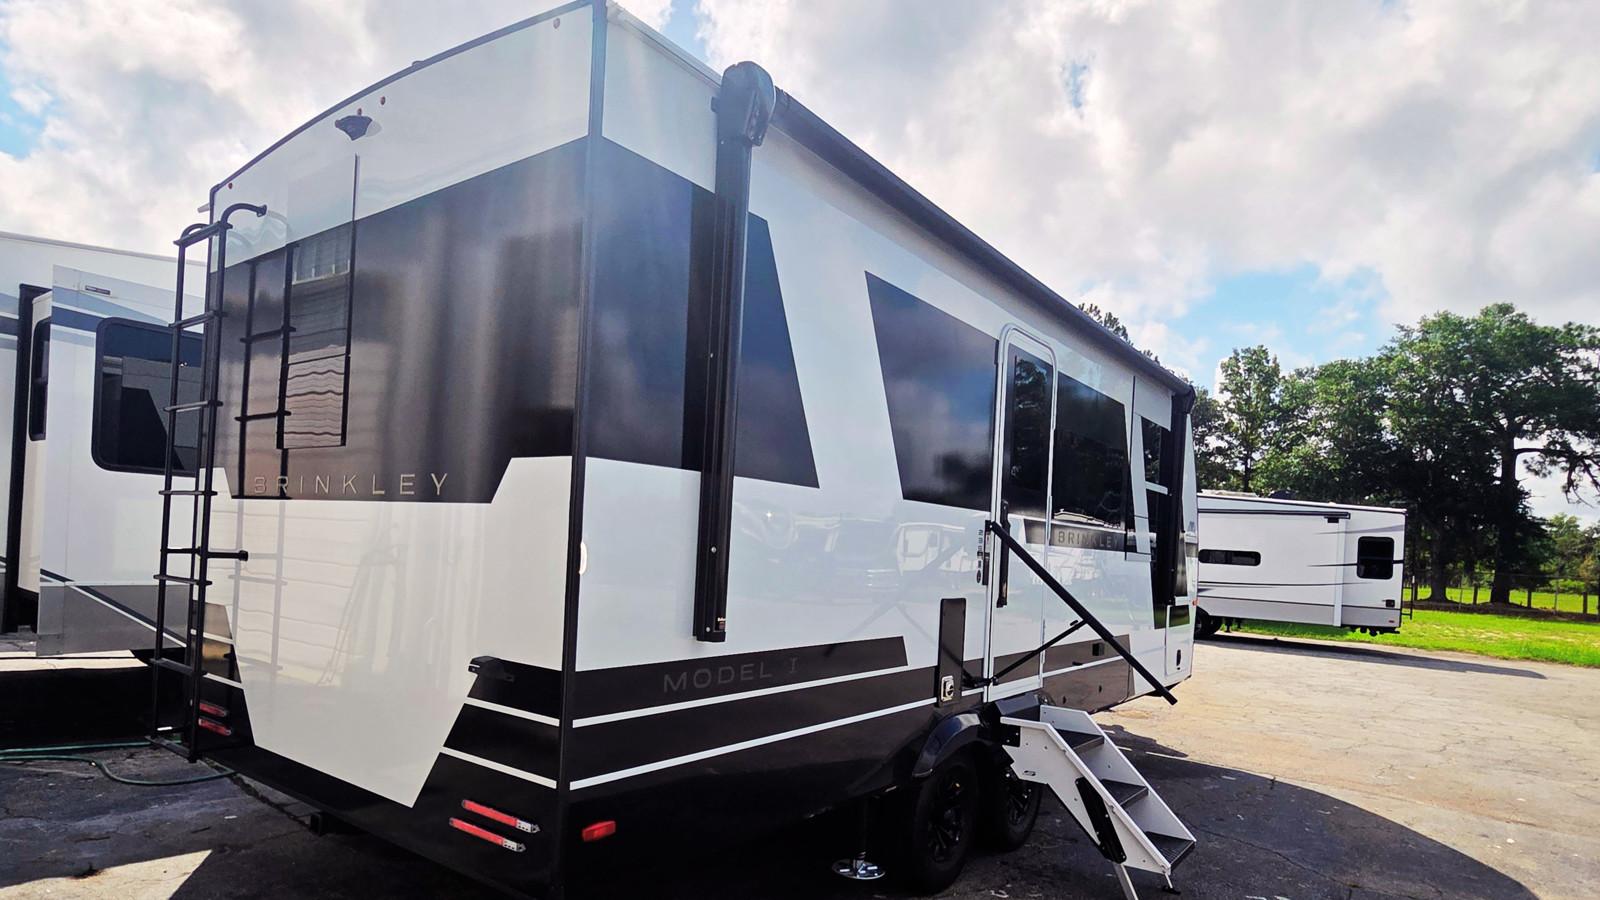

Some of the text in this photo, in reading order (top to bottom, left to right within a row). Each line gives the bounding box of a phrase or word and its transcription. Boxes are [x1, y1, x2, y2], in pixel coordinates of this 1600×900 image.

[254, 473, 448, 495] BRINKLEY
[663, 656, 799, 693] MODEL I
